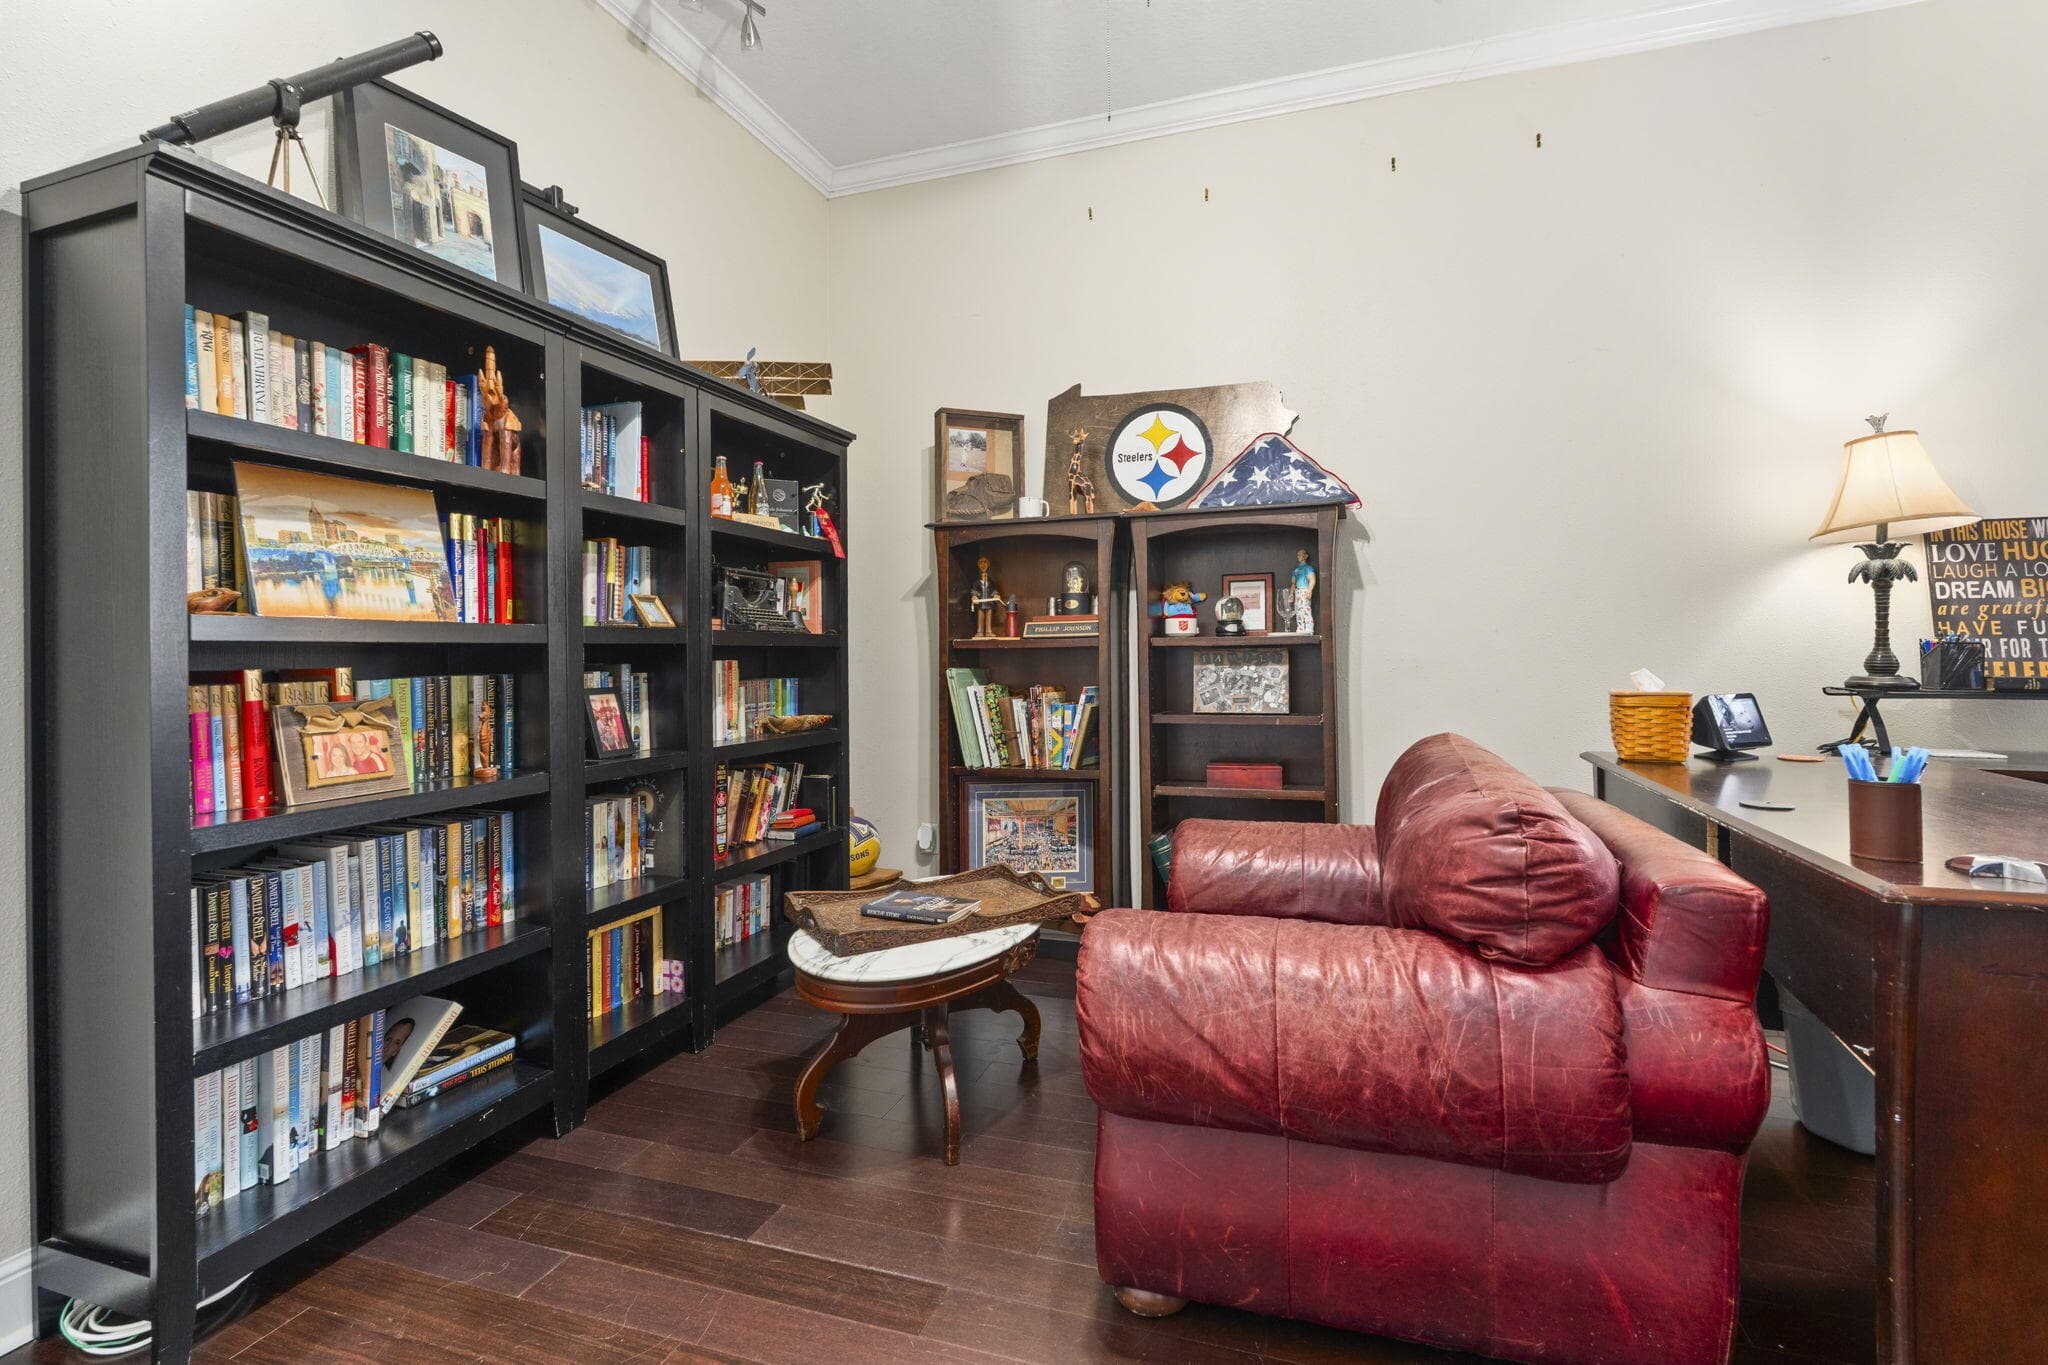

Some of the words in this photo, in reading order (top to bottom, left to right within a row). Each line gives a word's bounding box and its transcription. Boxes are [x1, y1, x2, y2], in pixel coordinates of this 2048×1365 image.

[200, 329, 213, 352] RING
[375, 350, 384, 371] FAMILY
[254, 331, 266, 416] REMEMBRANCE
[376, 371, 385, 391] ALBUM
[404, 370, 413, 391] DANIELLE
[354, 380, 366, 411] CIRCLE
[376, 391, 385, 412] DANIELLE
[404, 391, 413, 406] STEEL
[344, 394, 353, 439] CHANGES
[376, 412, 386, 428] STEEL
[1118, 453, 1153, 463] Steelers
[1931, 529, 1944, 541] IN
[1950, 522, 1978, 541] THIS
[1982, 520, 2028, 541] HOUSE
[220, 552, 233, 574] STEEL
[1931, 542, 1998, 563] LOVE
[1933, 563, 1998, 579] LAUGH
[2005, 563, 2018, 577] A
[1935, 580, 2015, 600] DREAM
[2021, 578, 2048, 598] BI
[1938, 604, 1969, 616] are
[1938, 620, 2003, 635] HAVE
[2000, 638, 2031, 659] FOR
[399, 682, 408, 714] DANIELLE
[427, 683, 435, 711] DANIELLE
[440, 680, 448, 706] DANIELLE
[400, 716, 409, 735] STEEL
[416, 707, 424, 726] STEEL
[427, 712, 435, 732] STEEL
[255, 758, 267, 788] RANSOM
[464, 824, 472, 854] DANIELLE
[493, 826, 501, 850] DANIELLE
[365, 842, 375, 878] DANIELLE
[381, 840, 390, 872] DANIELLE
[395, 838, 404, 866] DANIELLE
[493, 852, 501, 869] STEEL
[336, 850, 346, 883] DANIELLE
[464, 854, 472, 873] STEEL
[302, 869, 311, 900] DANIELLE
[383, 873, 391, 892] STEEL
[395, 867, 405, 885] STEEL
[251, 878, 263, 916] DANIELLE
[269, 877, 278, 908] DANIELLE
[285, 873, 295, 903] DANIELLE
[338, 883, 347, 904] STEEL
[367, 878, 376, 897] STEEL
[208, 891, 218, 921] DANIELLE
[221, 889, 231, 919] DANIELLE
[287, 903, 295, 922] STEEL
[303, 901, 312, 920] STEEL
[252, 916, 265, 940] STEEL
[270, 908, 279, 927] STEEL
[208, 922, 218, 942] STEEL
[221, 921, 232, 940] STEEL
[305, 934, 313, 966] WINNERS
[223, 963, 233, 993] Betrayal
[376, 1008, 386, 1044] DANIELLE
[436, 1010, 457, 1040] DANIELLE
[375, 1044, 383, 1065] STEEL
[421, 1037, 437, 1058] STEEL
[346, 1048, 356, 1071] STEEL
[488, 1053, 513, 1069] DANIELLE
[301, 1063, 310, 1084] STEEL
[470, 1064, 488, 1078] STEEL
[227, 1075, 239, 1109] DANIELLE
[246, 1084, 255, 1105] STEEL
[228, 1110, 239, 1131] STEEL
